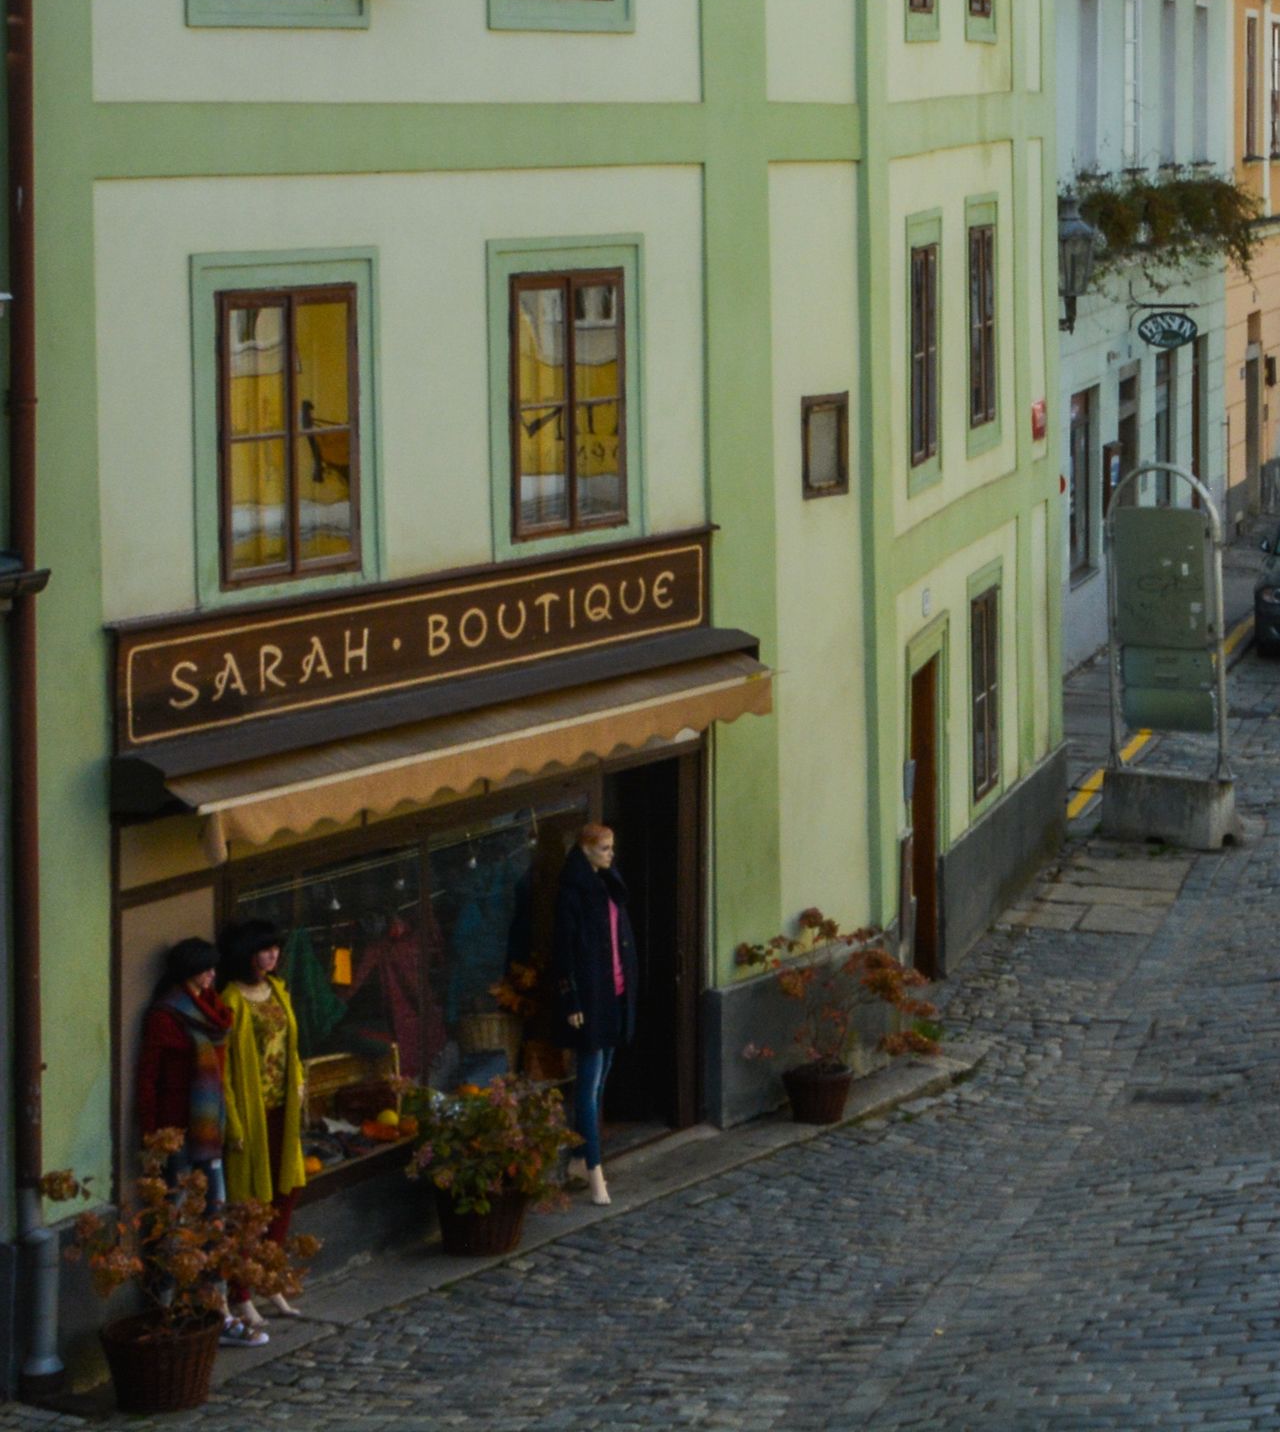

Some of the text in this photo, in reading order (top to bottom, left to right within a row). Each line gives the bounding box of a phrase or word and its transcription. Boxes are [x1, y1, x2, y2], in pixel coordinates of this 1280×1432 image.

[1140, 315, 1197, 339] PENSION
[169, 569, 677, 711] SARAH BOUTIQUE
